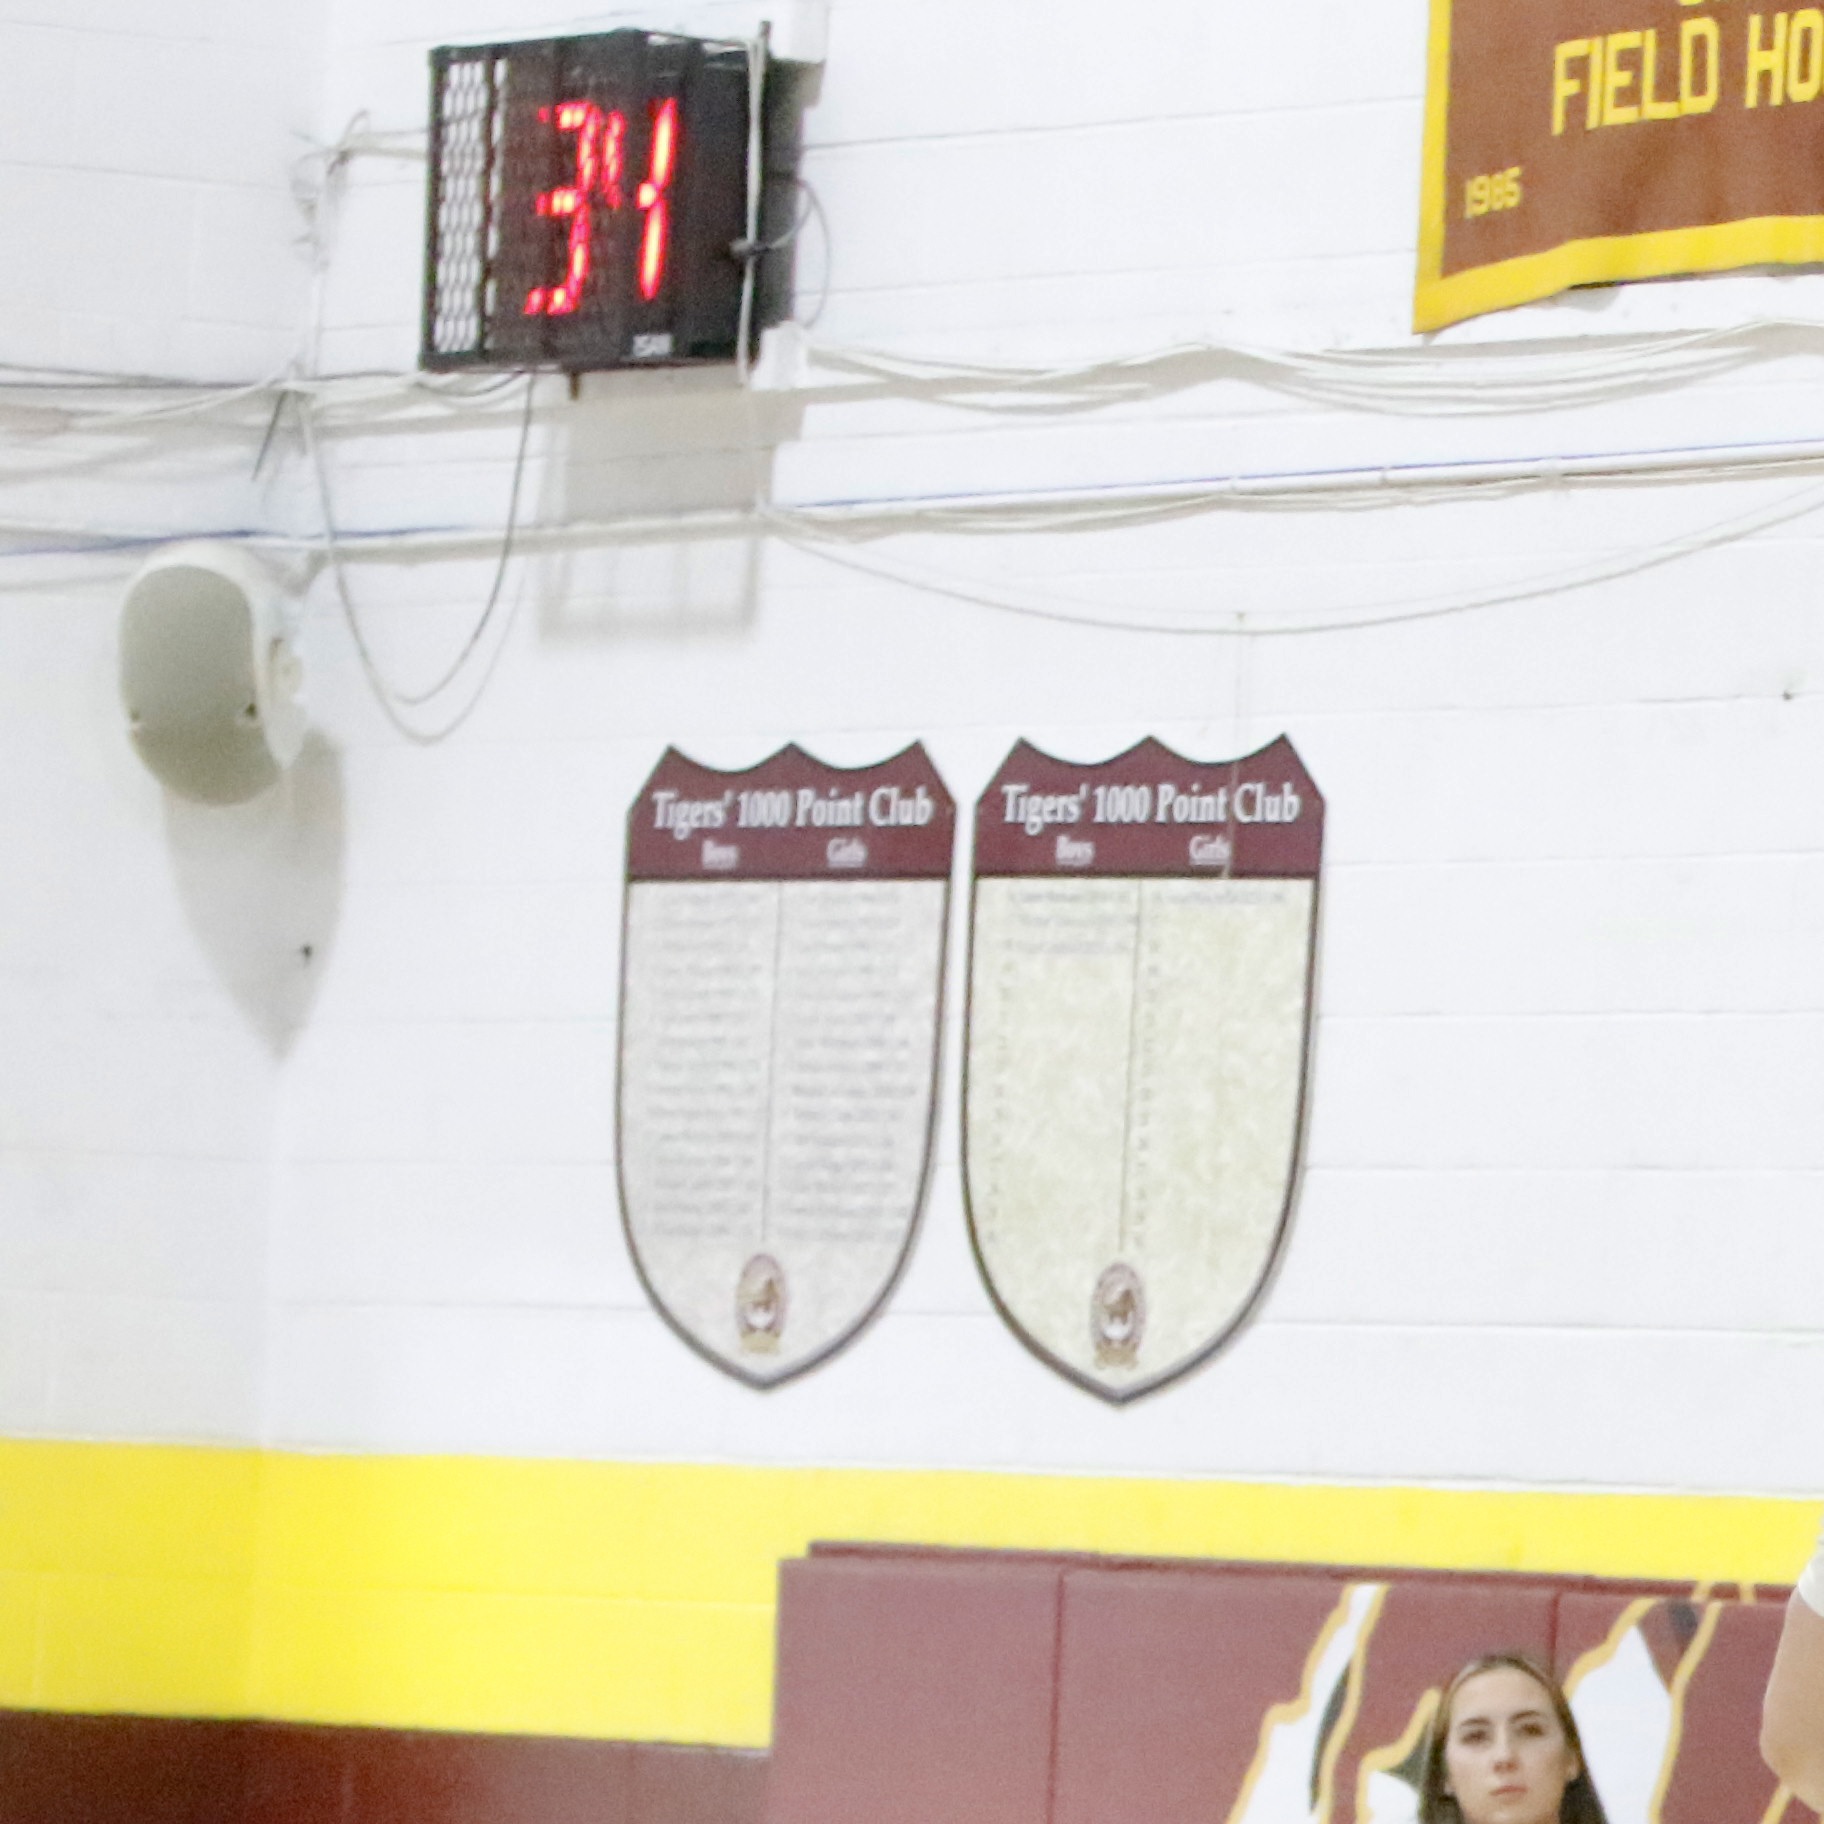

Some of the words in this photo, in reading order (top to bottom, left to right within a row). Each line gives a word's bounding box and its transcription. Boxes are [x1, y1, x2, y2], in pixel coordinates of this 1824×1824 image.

[1551, 15, 1721, 136] FIELD
[1463, 165, 1523, 219] 1985
[652, 789, 734, 840] Tigers'
[736, 789, 792, 828] 1000
[795, 787, 865, 828] Point
[868, 784, 935, 827] Club
[1001, 782, 1090, 836] Tigers'
[1093, 783, 1151, 824] 1000
[1155, 783, 1228, 824] Point
[1232, 781, 1302, 824] Club
